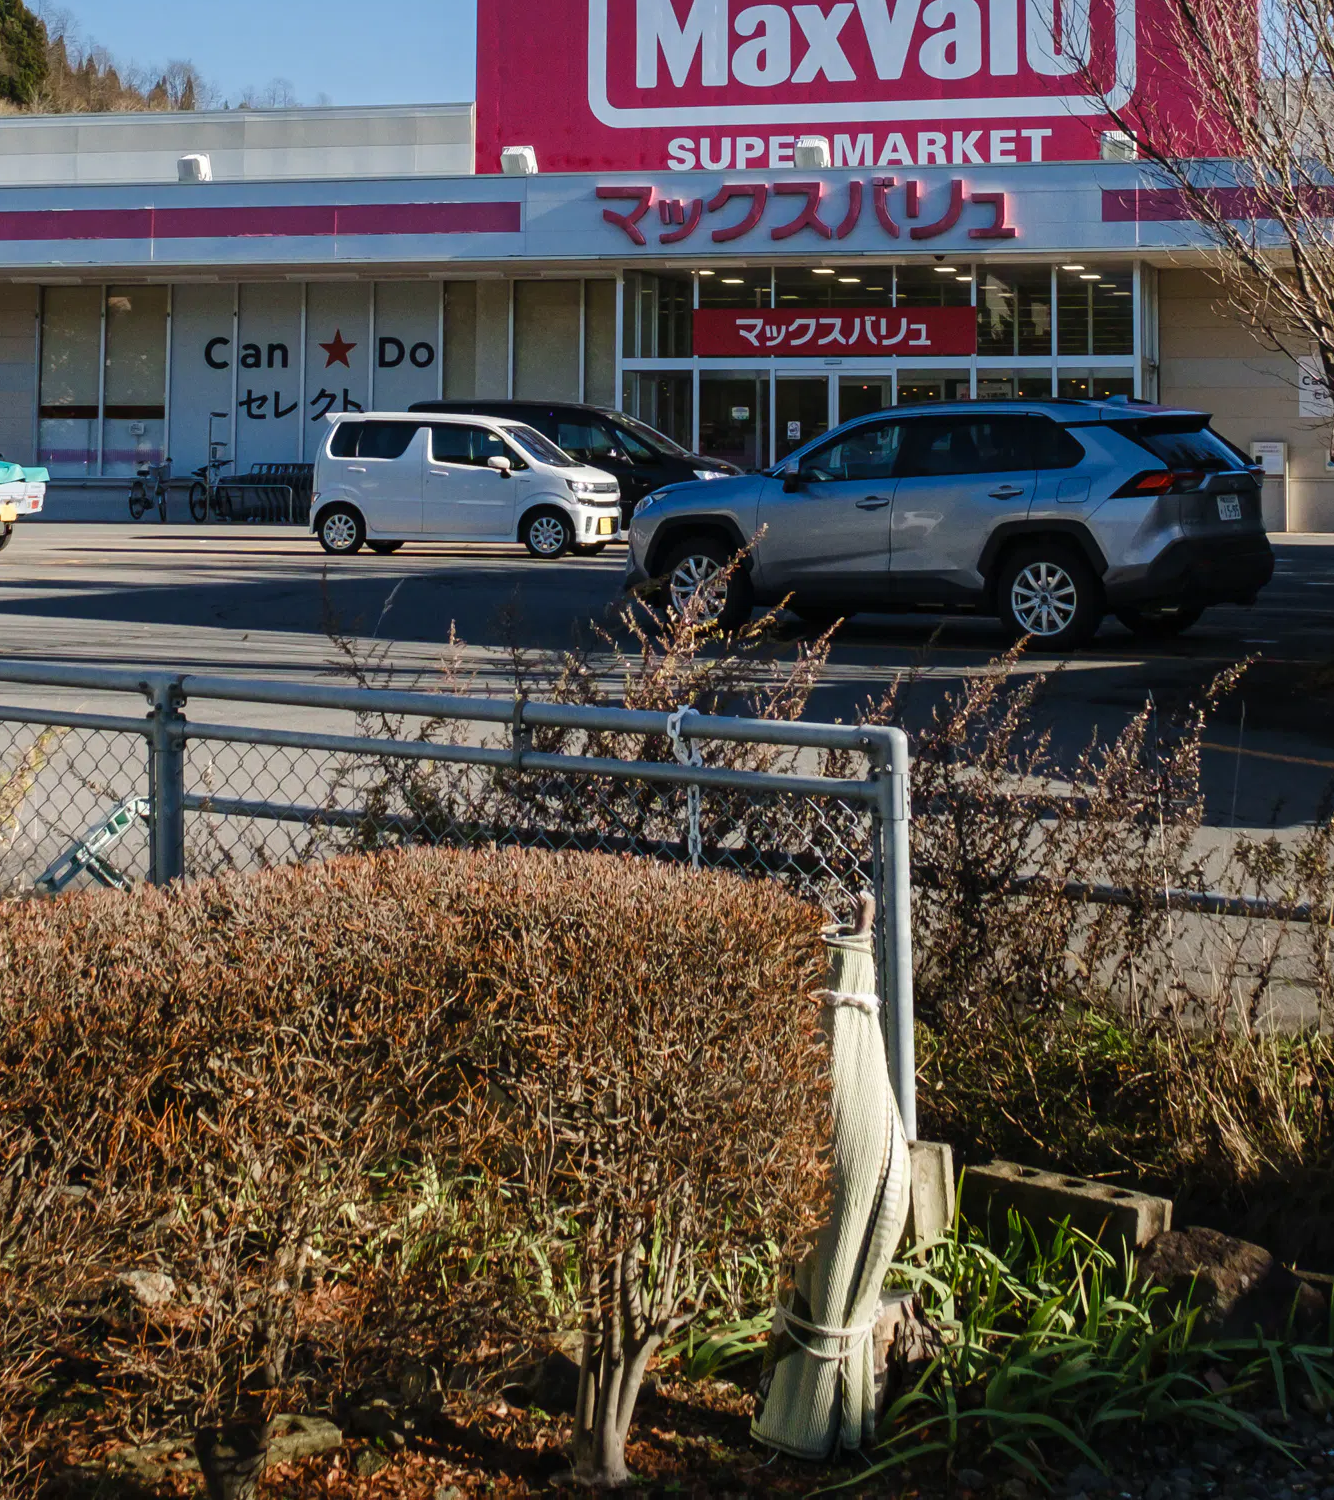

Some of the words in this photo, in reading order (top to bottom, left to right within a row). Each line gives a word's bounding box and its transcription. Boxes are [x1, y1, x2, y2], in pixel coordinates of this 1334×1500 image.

[667, 128, 1053, 172] SUPEMARKET
[595, 176, 1018, 246] マックスバリュ
[735, 316, 932, 347] マックスバリュ
[204, 336, 289, 370] Can
[378, 336, 435, 369] Do
[238, 387, 366, 422] セレクト
